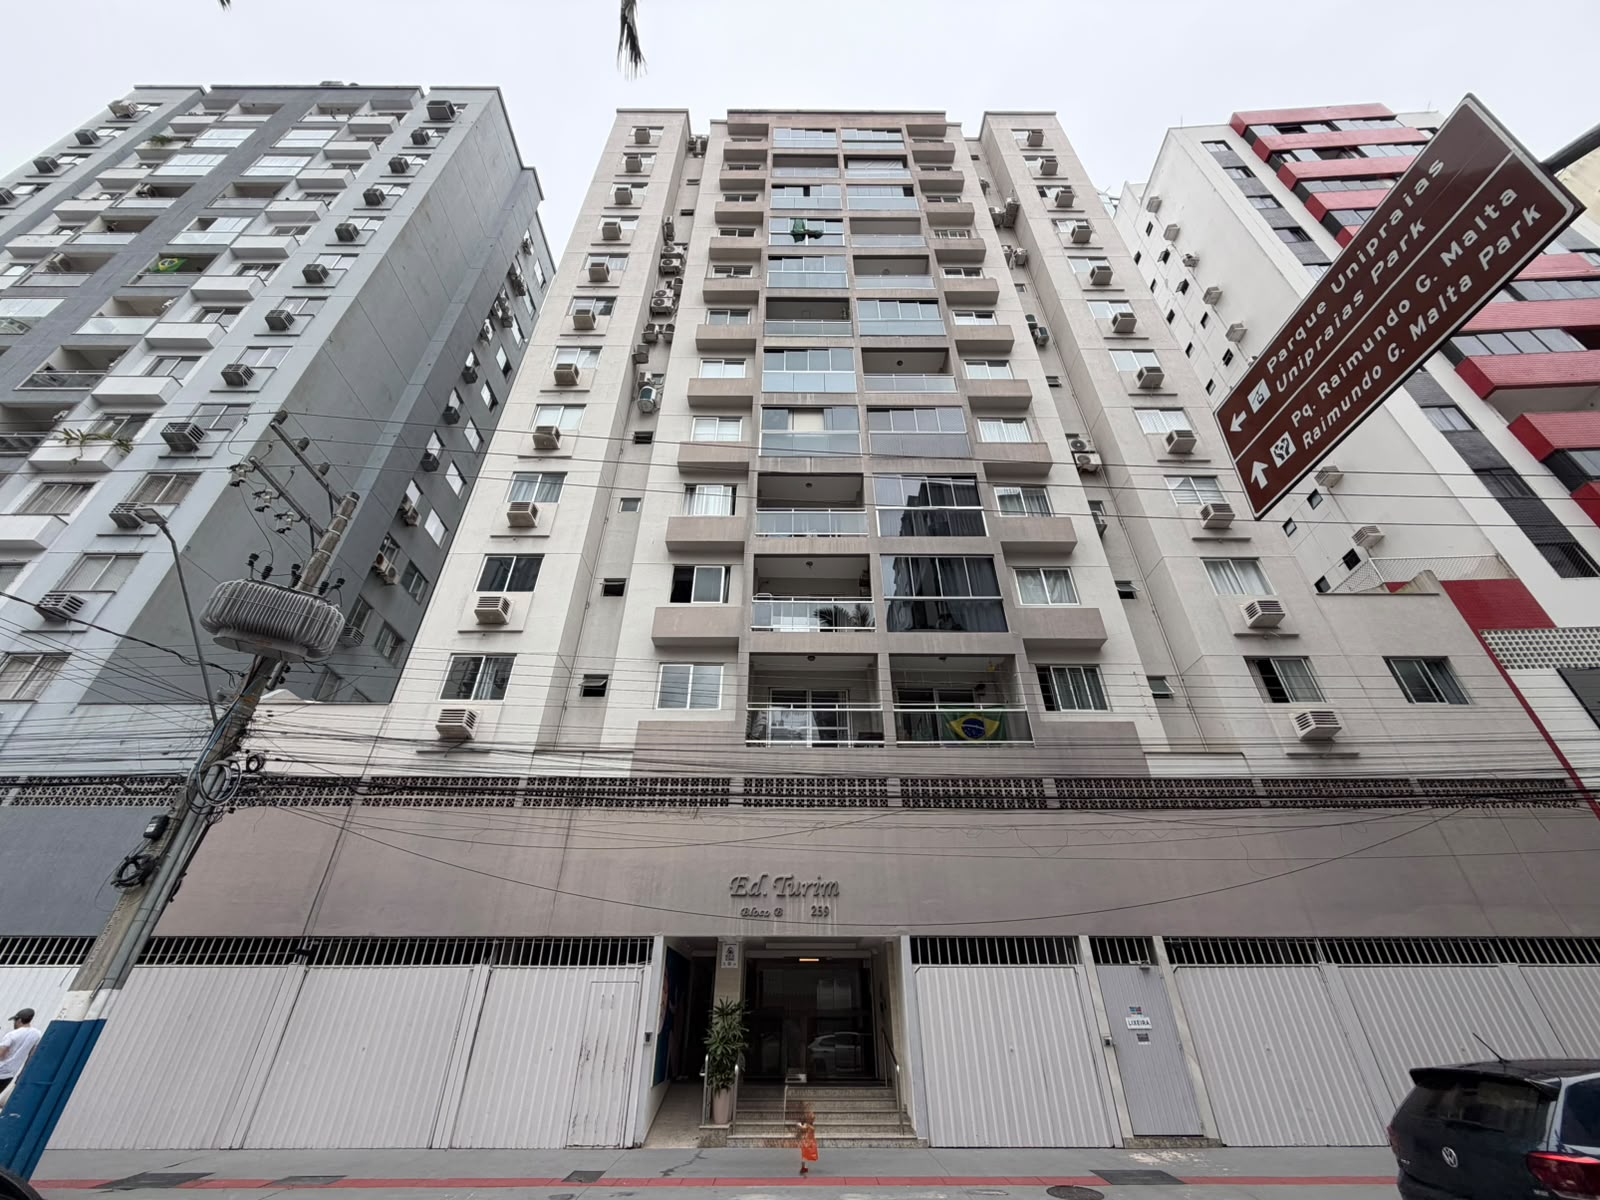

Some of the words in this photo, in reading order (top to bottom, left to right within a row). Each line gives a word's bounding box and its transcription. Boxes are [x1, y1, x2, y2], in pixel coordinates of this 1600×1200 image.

[1266, 301, 1327, 374] Parque
[1330, 159, 1444, 294] Unipraias
[1276, 289, 1364, 393] Unipraias
[1370, 219, 1427, 285] Park
[1291, 403, 1316, 428] Pq.
[1317, 299, 1410, 400] Raimundo
[1415, 273, 1439, 294] G.
[1440, 187, 1518, 267] Malta
[1302, 365, 1382, 450] Raimundo
[1387, 342, 1405, 363] G.
[1409, 275, 1473, 341] Malta
[1478, 202, 1542, 271] Park
[729, 873, 769, 898] Ed.
[772, 873, 840, 898] Turim
